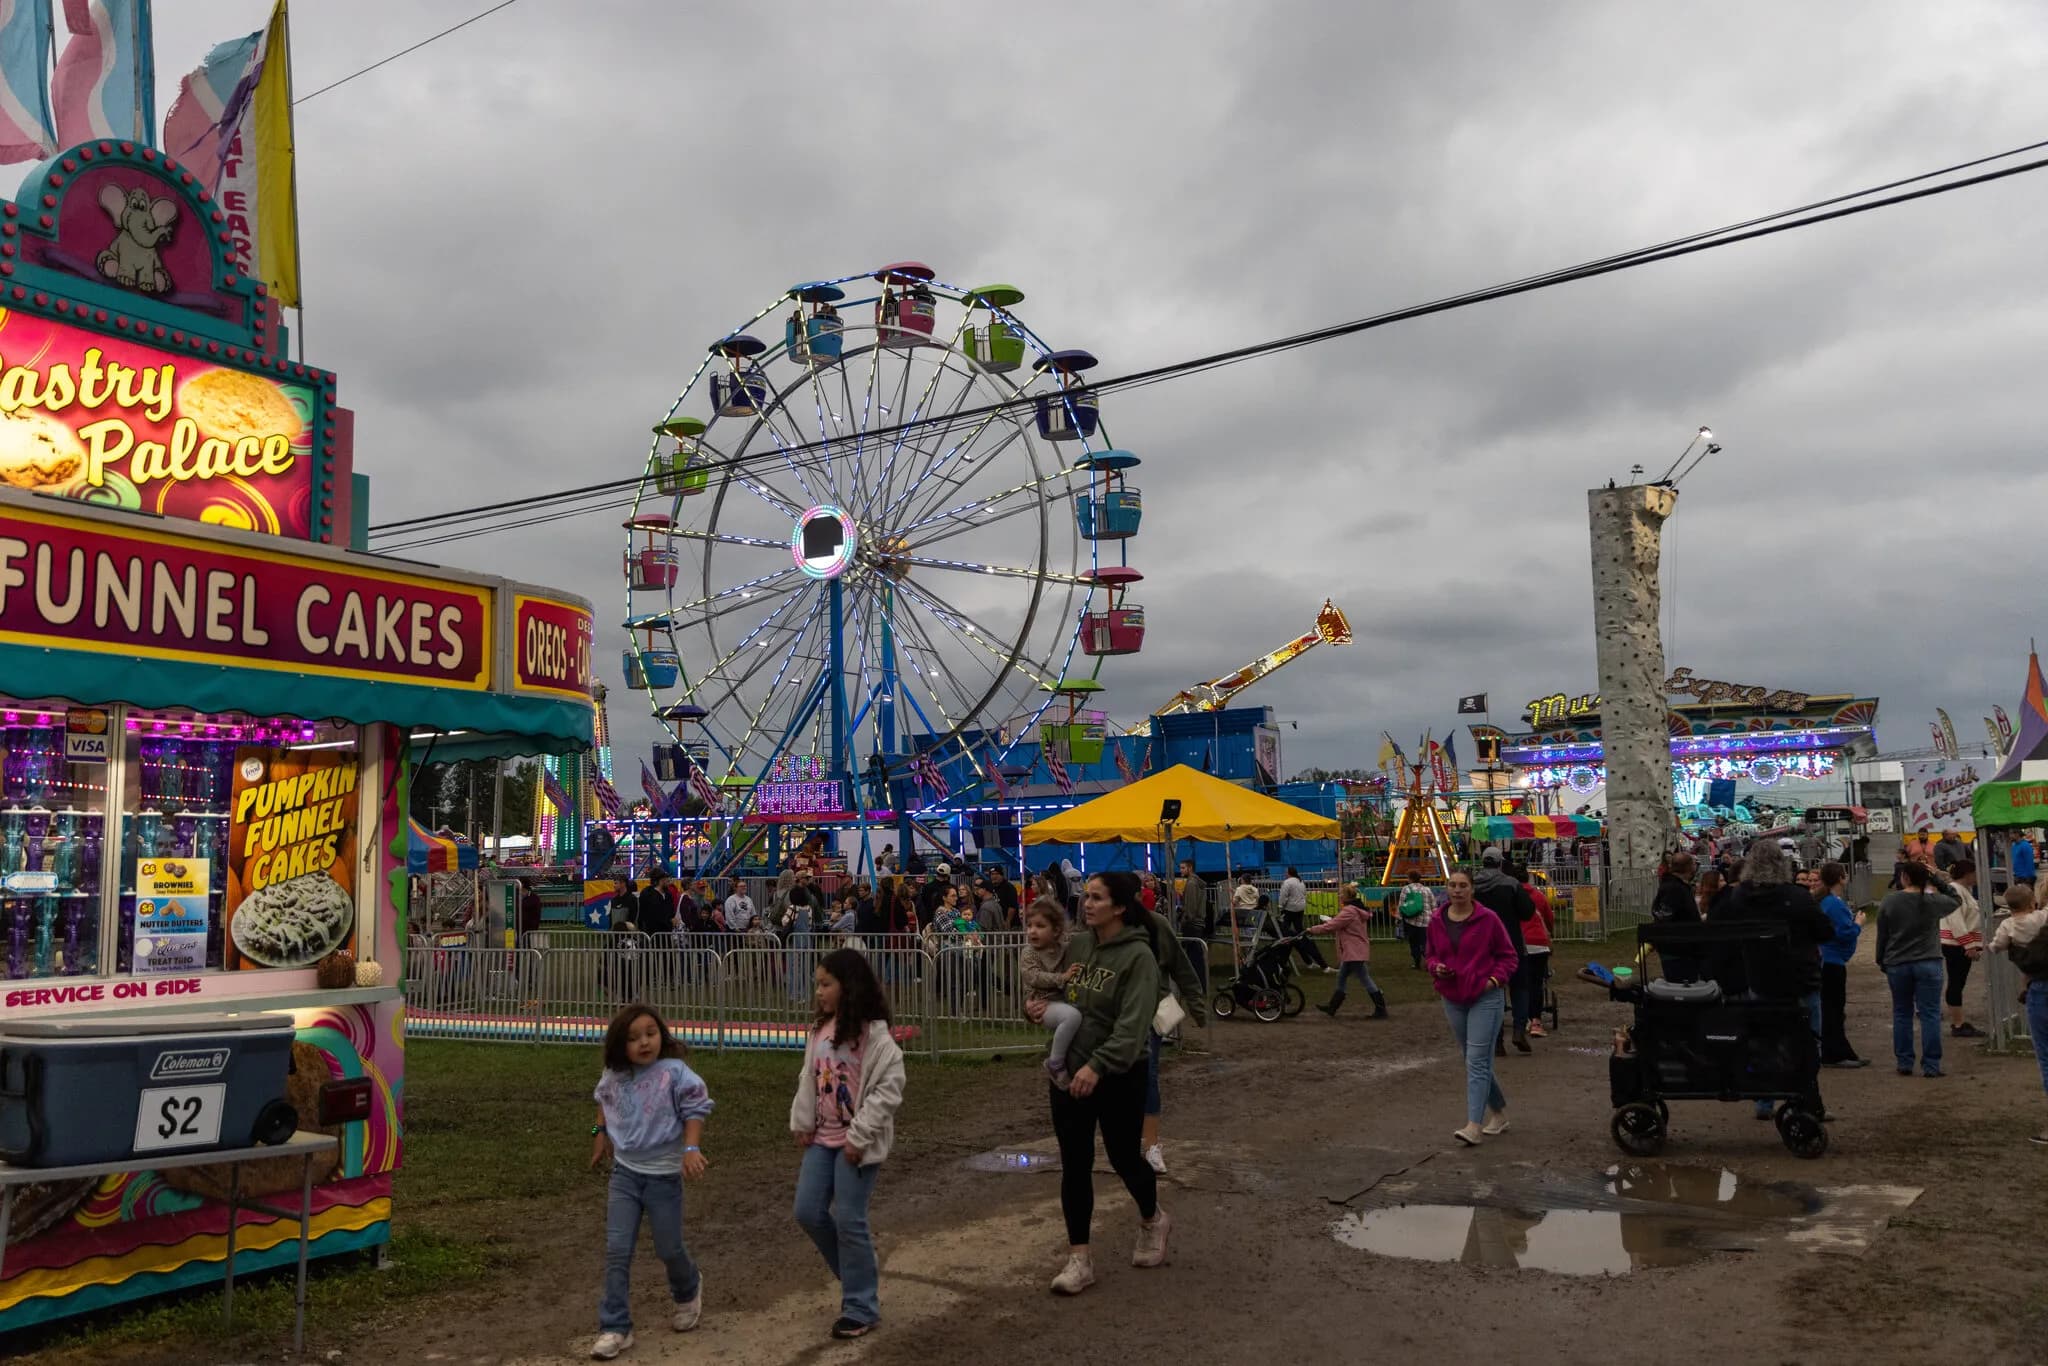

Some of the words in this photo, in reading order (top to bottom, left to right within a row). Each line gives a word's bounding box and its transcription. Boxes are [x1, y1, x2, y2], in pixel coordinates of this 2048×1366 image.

[0, 347, 175, 423] astry
[77, 417, 294, 487] Palace
[0, 537, 269, 646] FUNNEL
[296, 584, 463, 670] CAKES
[527, 616, 567, 681] OREOS
[1664, 667, 1810, 712] Express
[72, 740, 105, 753] VISA
[772, 754, 826, 782] EXPO
[1924, 765, 1980, 800] Musik
[236, 760, 358, 824] PUMPKIN
[757, 781, 844, 814] WHEEL
[244, 798, 345, 858] FUNNEL
[1817, 810, 1841, 820] EXIT
[142, 864, 156, 875] $6
[252, 834, 338, 891] CAKES
[153, 881, 194, 889] BROWNIES
[140, 902, 154, 914] $6
[140, 920, 170, 929] NUTTER
[171, 918, 204, 928] BUTTERS
[148, 957, 173, 967] TREAT
[174, 956, 194, 966] TRIO
[6, 985, 105, 1007] SERVICE
[113, 982, 148, 999] ON
[155, 979, 202, 996] SIDE
[161, 1054, 211, 1071] Coleman
[158, 1096, 203, 1139] $2
